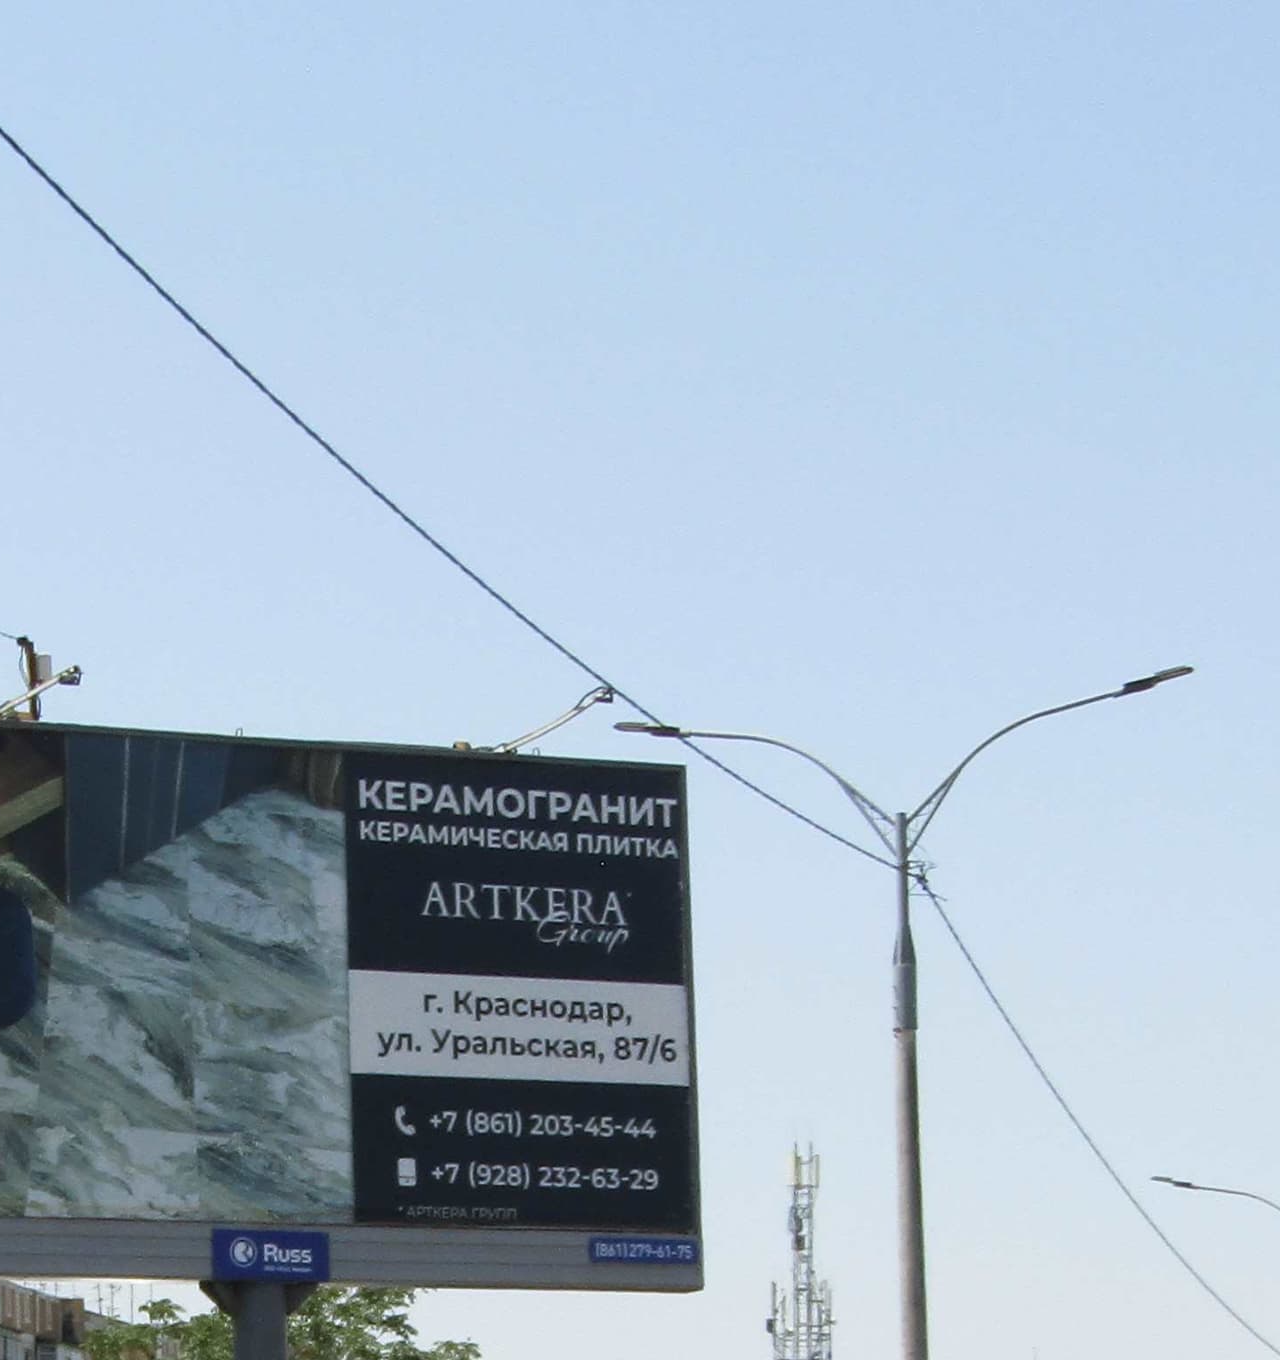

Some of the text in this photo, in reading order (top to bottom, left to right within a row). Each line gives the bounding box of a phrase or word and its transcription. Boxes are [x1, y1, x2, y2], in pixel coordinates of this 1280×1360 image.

[357, 779, 678, 828] КЕРАМОГРАНИТ
[359, 820, 679, 860] КЕРАМИЧЕСКАЯ ПЛИТКА
[536, 911, 630, 953] Group
[423, 990, 633, 1027] г. Краснодар,
[377, 1028, 677, 1064] ул. Уральская, 87/6
[429, 1109, 657, 1140] +7 (861) 203-45-44
[431, 1161, 659, 1190] +7 (928) 232-63-29
[263, 1243, 313, 1264] Russ
